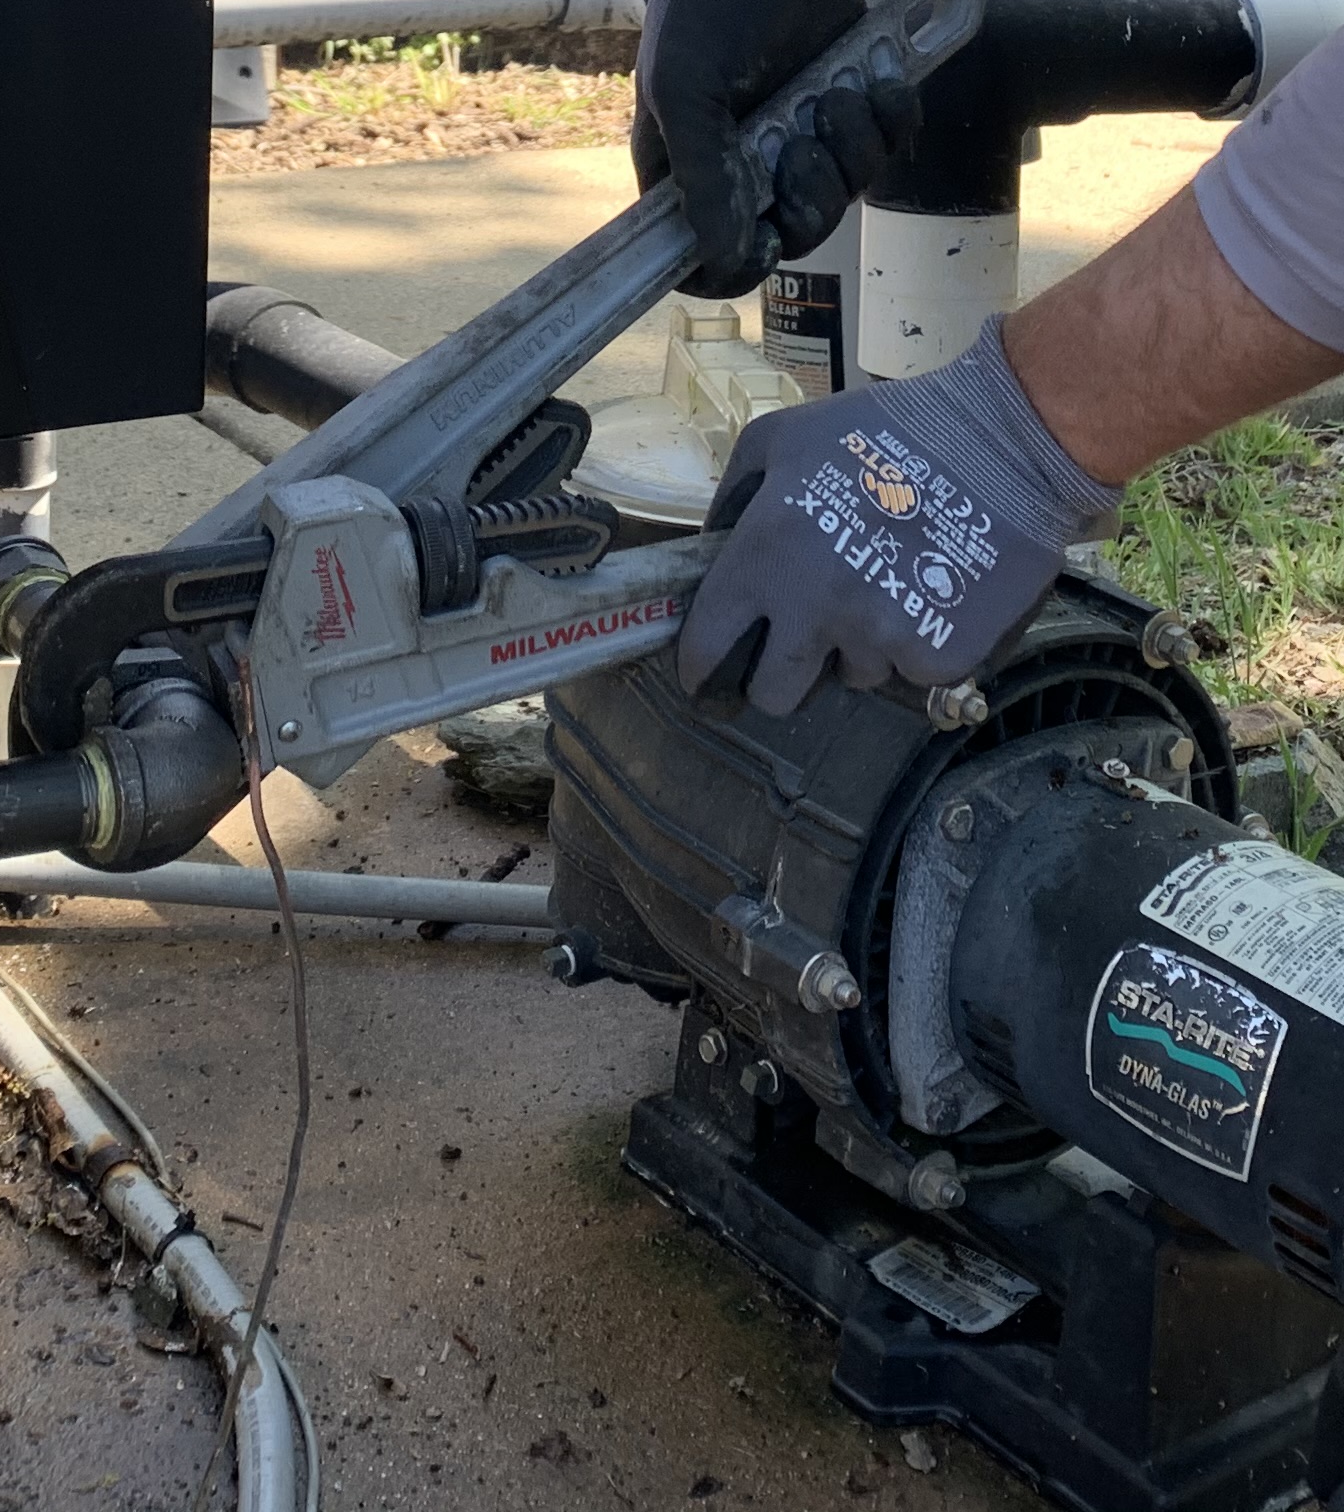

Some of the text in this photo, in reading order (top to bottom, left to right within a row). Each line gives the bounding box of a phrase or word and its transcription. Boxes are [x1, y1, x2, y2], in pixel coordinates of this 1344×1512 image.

[808, 477, 866, 534] ULTIMATE
[311, 545, 348, 642] Milwaukee
[796, 490, 954, 650] MaxiFlex
[490, 598, 686, 665] MILWAUKEE
[1117, 980, 1255, 1073] STA-RITE
